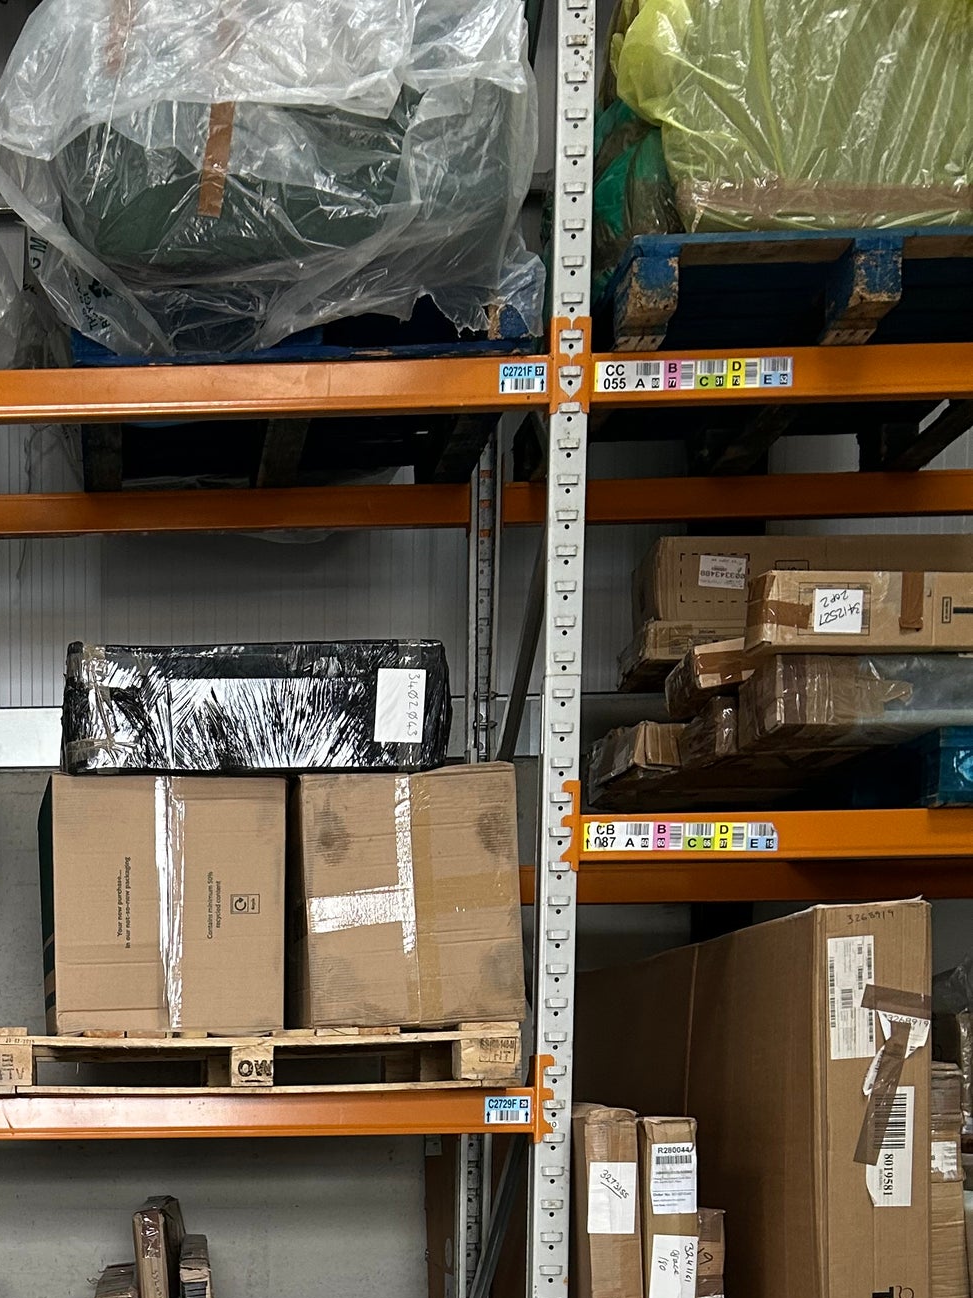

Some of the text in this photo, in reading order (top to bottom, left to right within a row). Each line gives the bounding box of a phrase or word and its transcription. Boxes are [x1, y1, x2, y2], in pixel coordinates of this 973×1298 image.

[503, 366, 532, 377] C2721F
[606, 365, 624, 376] CC
[668, 363, 677, 373] B
[733, 361, 741, 371] D
[603, 378, 626, 389] 055
[635, 379, 645, 388] A
[700, 377, 709, 386] C
[764, 375, 772, 384] E
[819, 602, 861, 626] 3412527
[597, 824, 615, 835] CB
[658, 825, 666, 834] B
[720, 825, 729, 834] D
[595, 837, 616, 848] 087
[625, 838, 635, 847] A
[688, 838, 696, 848] C
[750, 839, 758, 848] E
[488, 1099, 517, 1109] C2729F
[883, 1153, 894, 1196] 8019581
